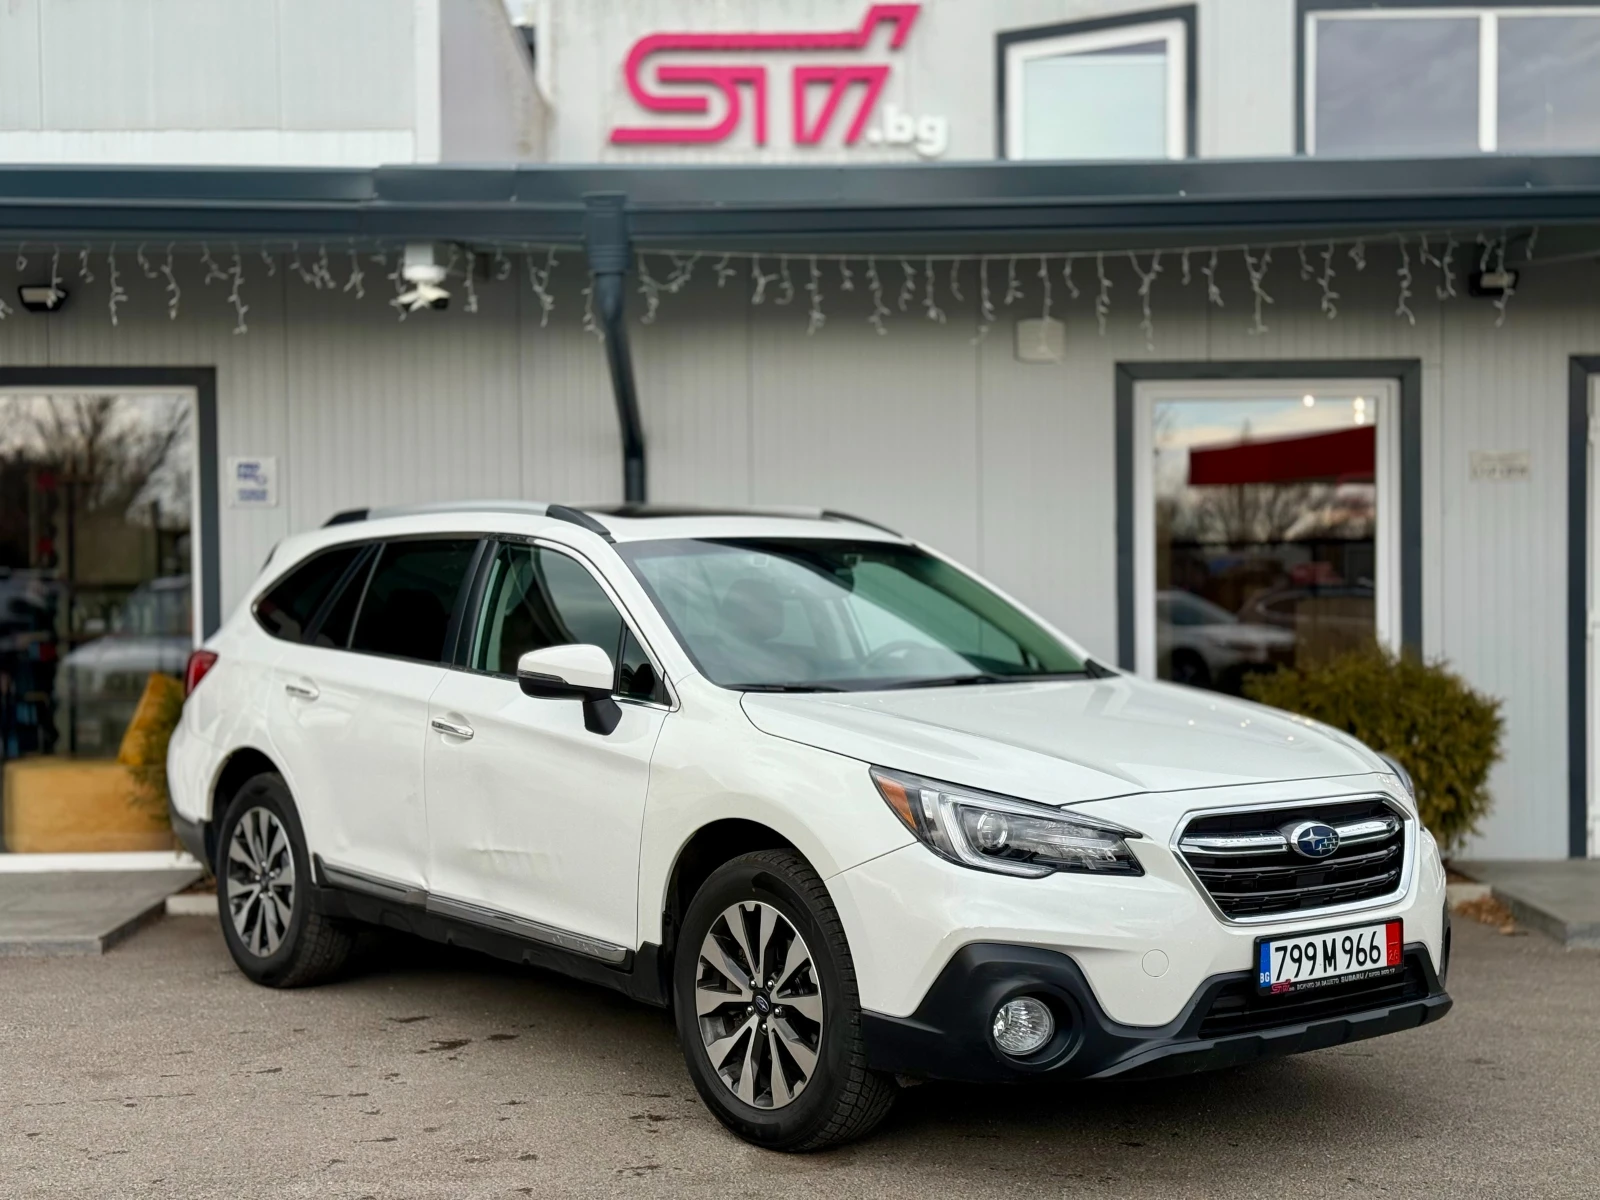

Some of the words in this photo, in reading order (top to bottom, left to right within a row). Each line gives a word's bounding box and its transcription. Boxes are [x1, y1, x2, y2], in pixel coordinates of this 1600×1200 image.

[1274, 941, 1318, 982] 799
[1322, 938, 1337, 973] M
[1341, 930, 1381, 970] 966
[1260, 972, 1270, 984] BG
